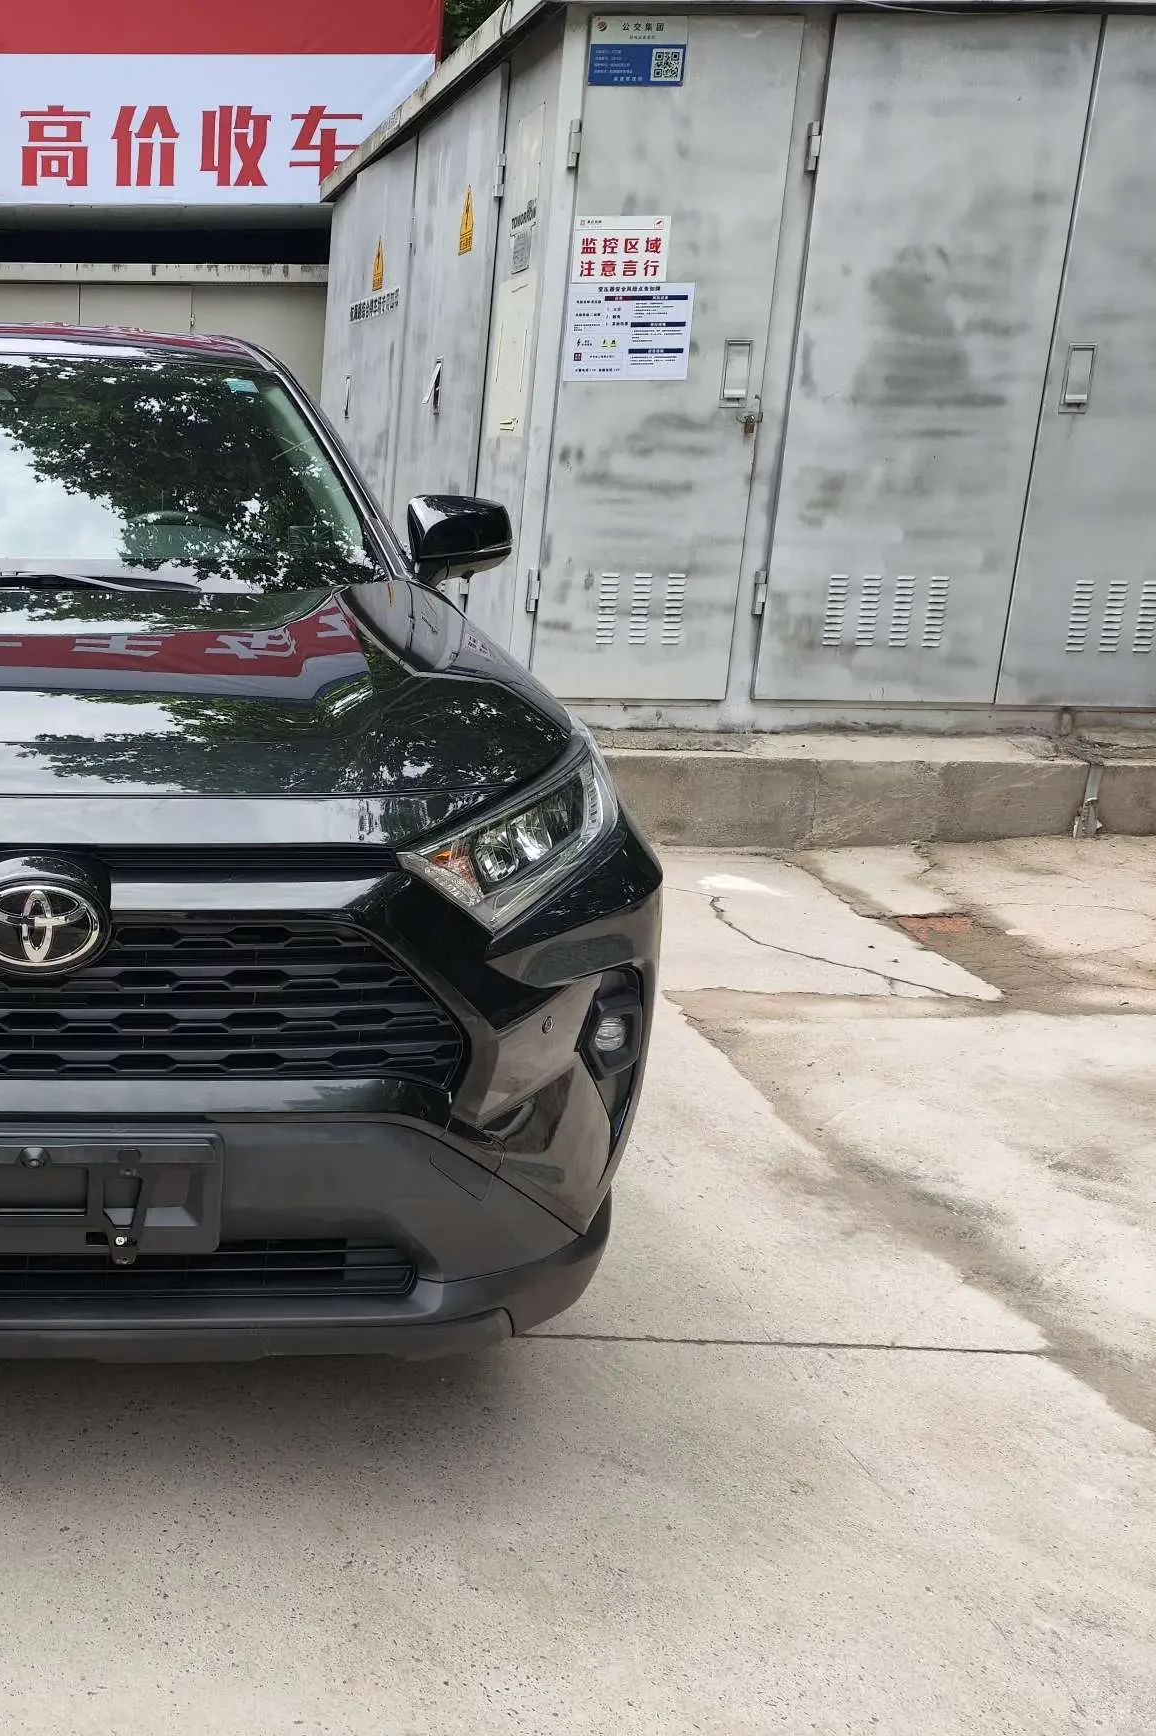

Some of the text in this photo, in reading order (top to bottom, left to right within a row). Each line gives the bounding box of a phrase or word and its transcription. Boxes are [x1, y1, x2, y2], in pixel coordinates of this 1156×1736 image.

[622, 22, 664, 32] 公交集团
[20, 105, 363, 187] 高价收车
[580, 237, 662, 254] 监控区域
[579, 260, 660, 277] 注意言行
